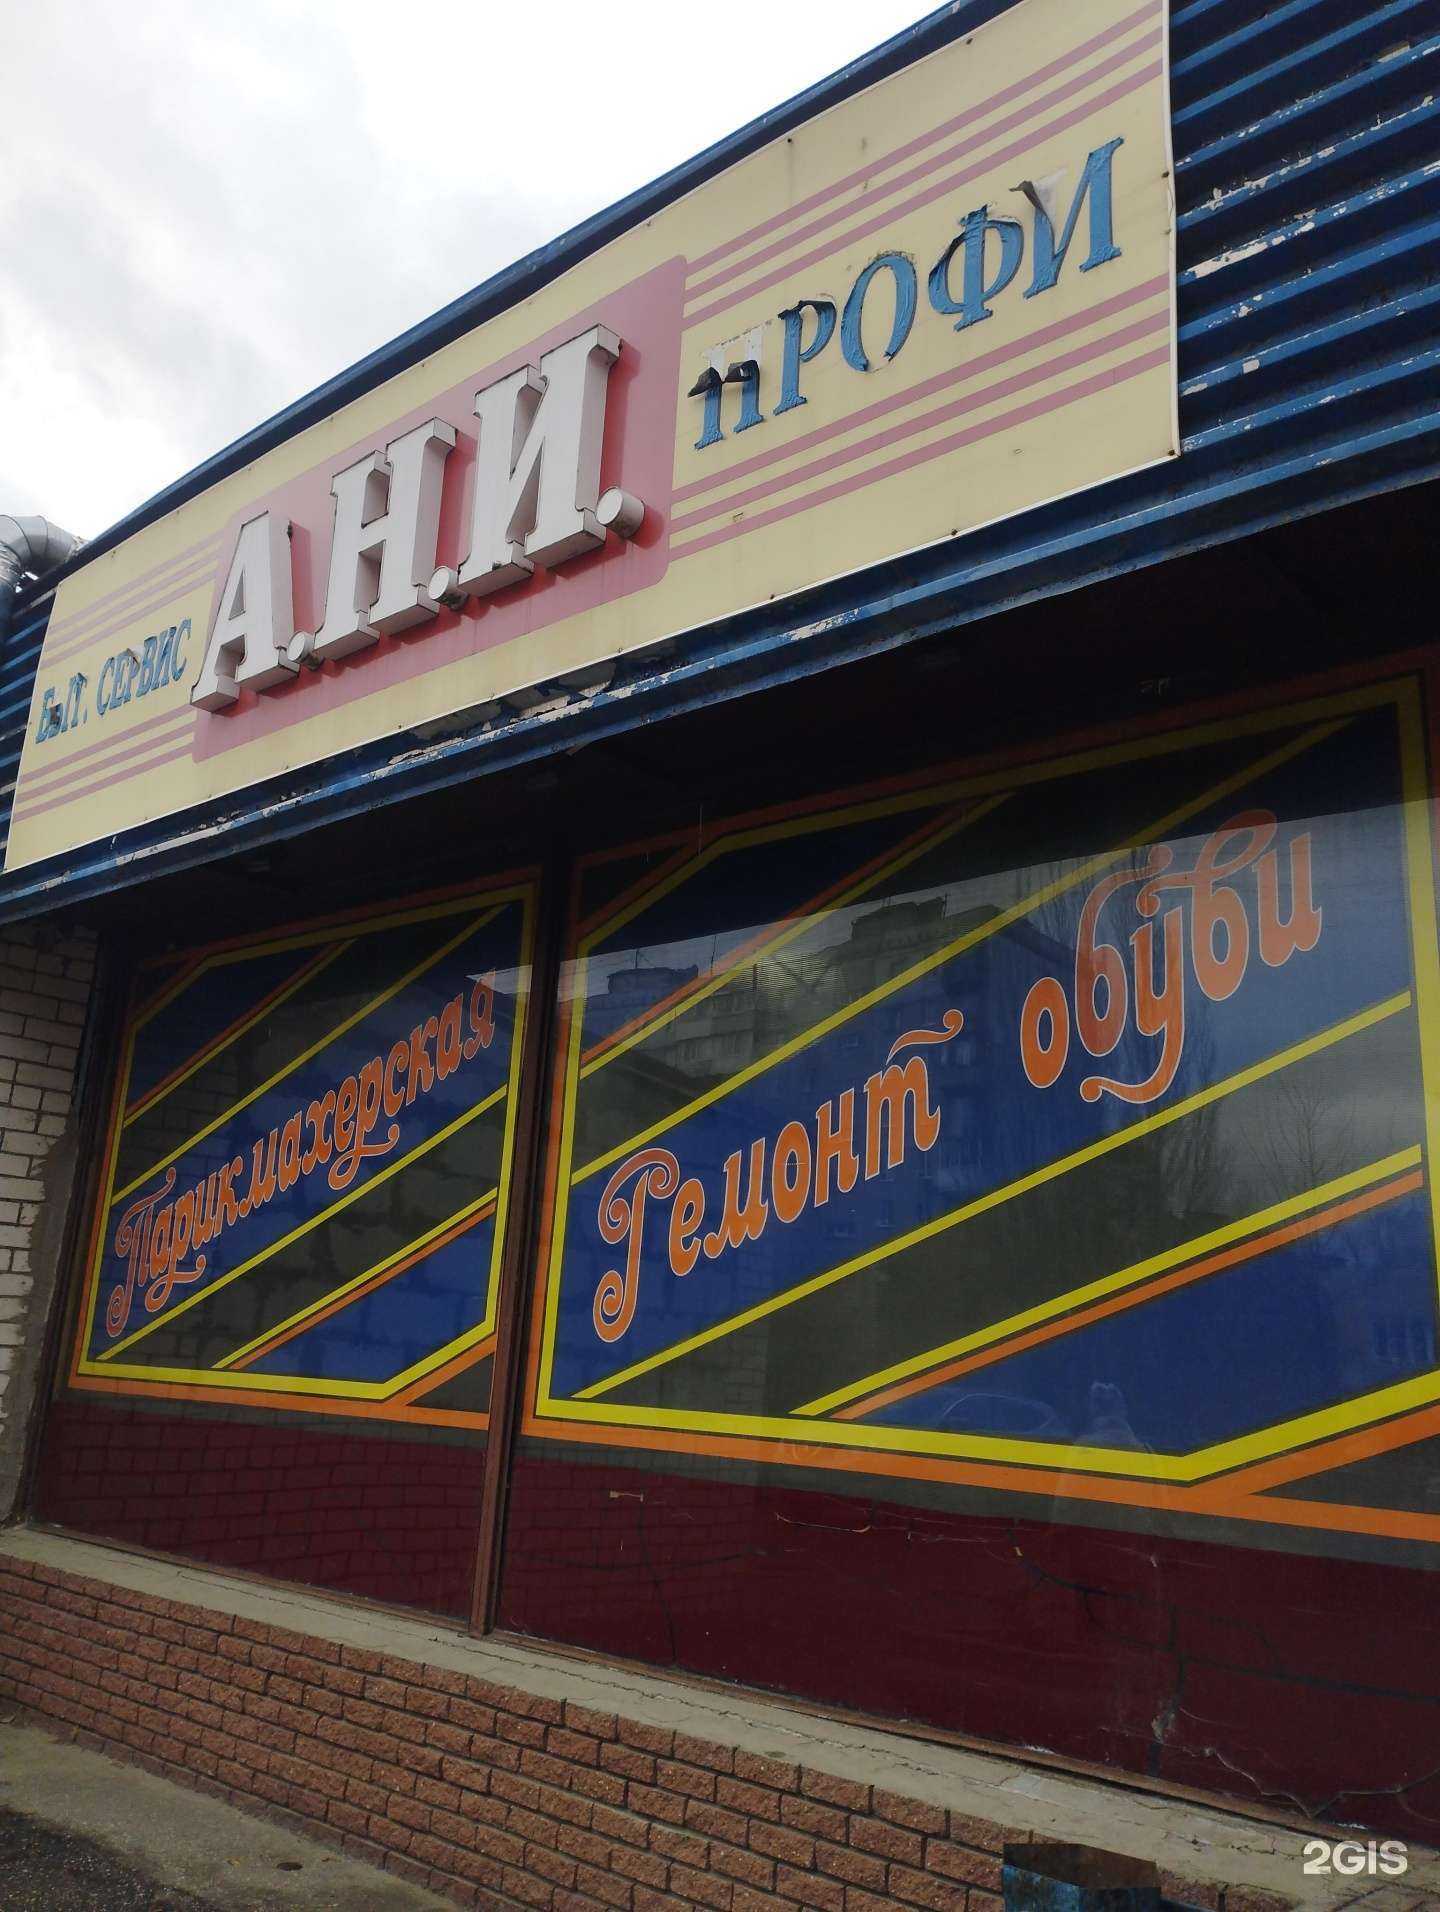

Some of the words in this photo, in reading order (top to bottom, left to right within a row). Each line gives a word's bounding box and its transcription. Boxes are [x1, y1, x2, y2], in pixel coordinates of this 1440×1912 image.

[688, 136, 1126, 450] ПРОФИ
[96, 618, 192, 716] СЕРВИС
[105, 968, 496, 1338] Парикмахерская
[592, 1008, 965, 1344] Ремонт
[1020, 808, 1323, 1104] обуви
